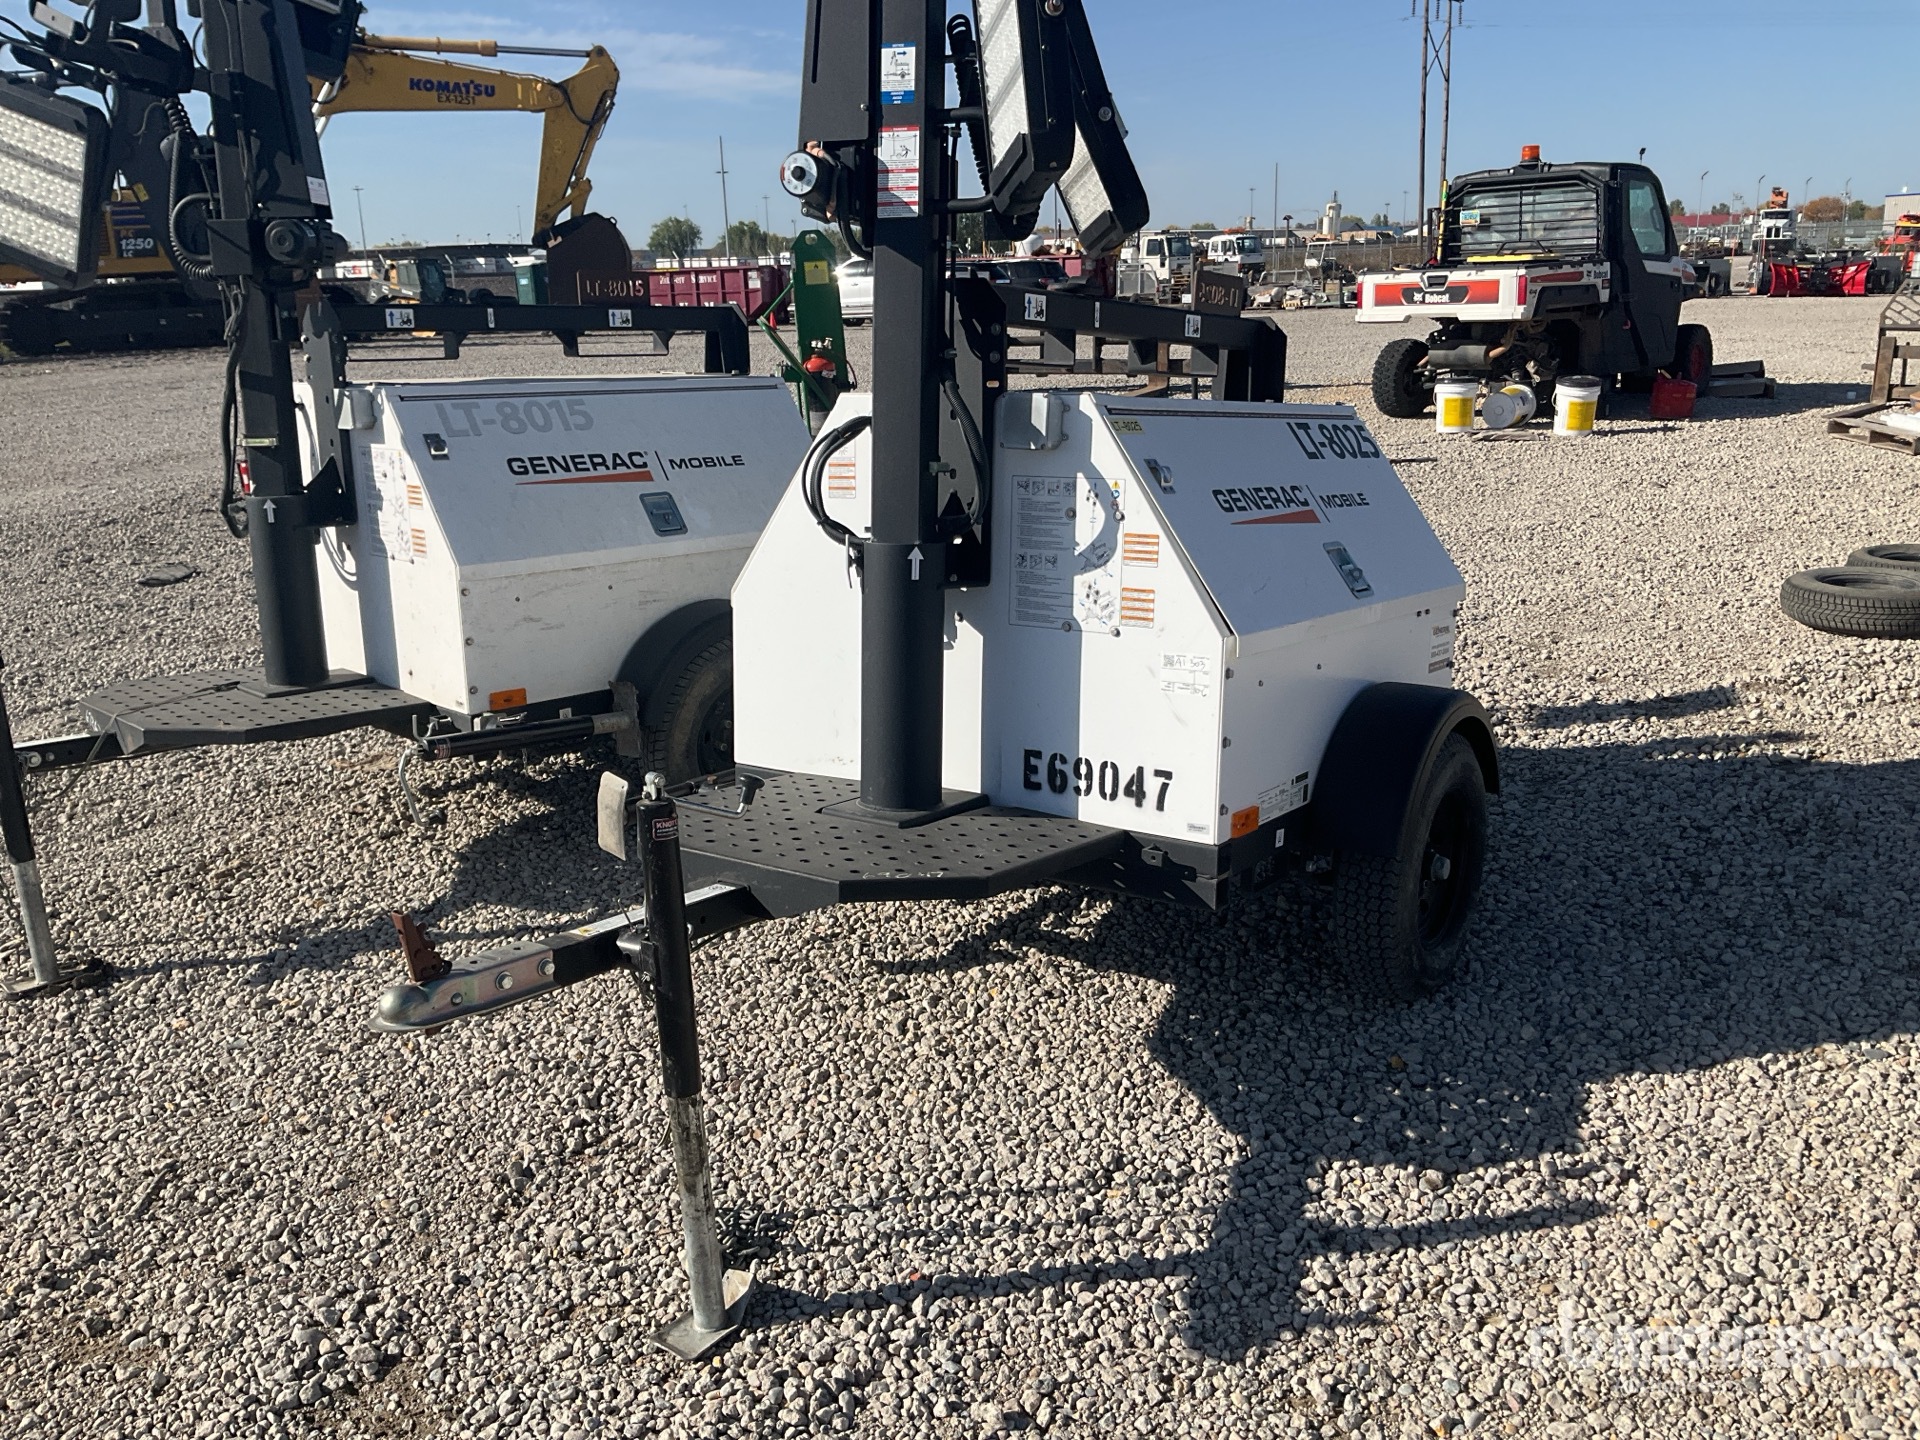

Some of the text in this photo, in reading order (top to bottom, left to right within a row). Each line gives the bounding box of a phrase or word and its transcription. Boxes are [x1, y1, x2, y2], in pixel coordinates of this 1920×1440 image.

[409, 77, 496, 98] KOMATSU
[119, 237, 154, 250] 1250
[1424, 293, 1450, 304] Bobcat
[434, 399, 595, 438] LT-8015
[1286, 421, 1381, 460] LT-8025
[506, 451, 745, 476] GENERAC MOBILE
[1212, 485, 1370, 513] GENERAC MOBILE
[1023, 748, 1173, 812] E69047
